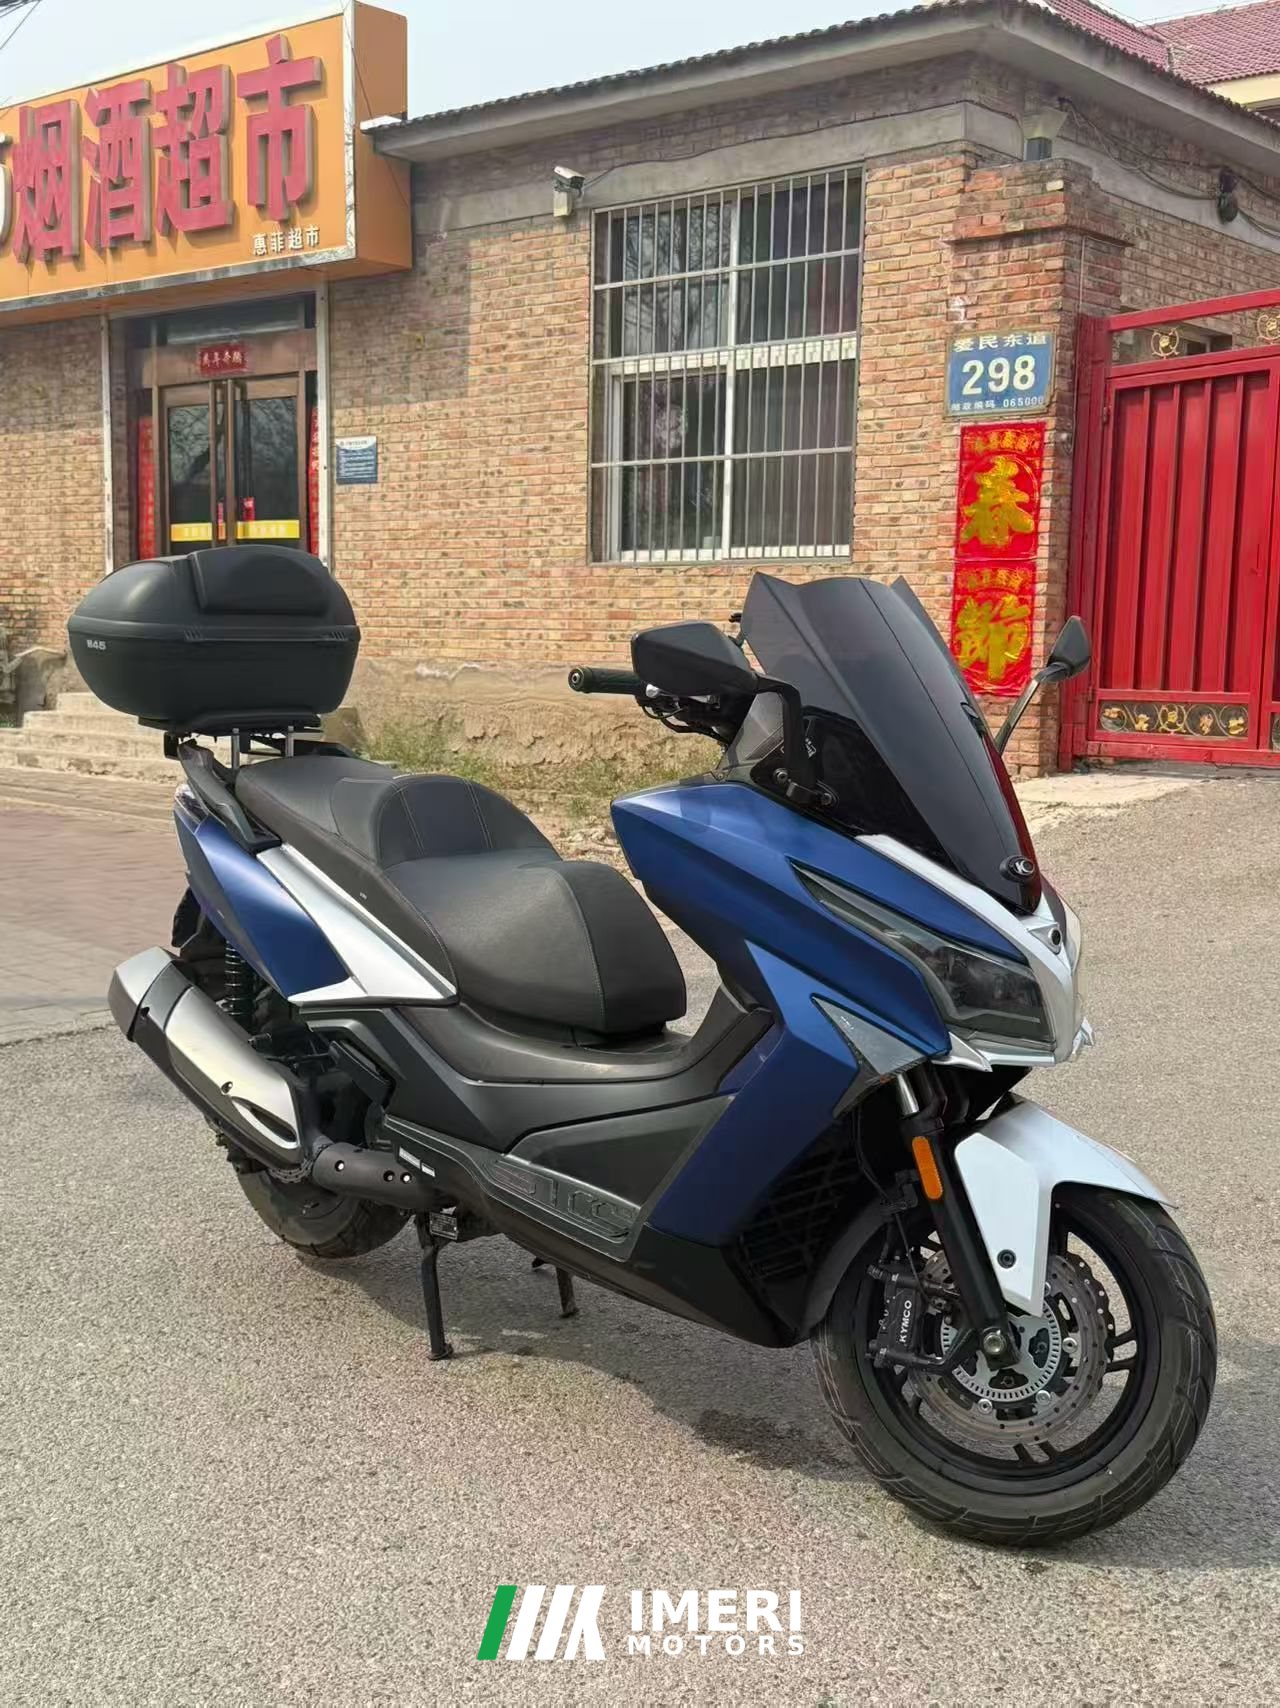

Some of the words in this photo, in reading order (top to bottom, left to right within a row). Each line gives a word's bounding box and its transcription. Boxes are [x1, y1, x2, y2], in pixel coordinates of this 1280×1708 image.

[12, 34, 320, 264] 烟酒超市
[252, 226, 320, 256] 惠菲超市
[954, 332, 1047, 352] 爱民东道
[962, 354, 1035, 395] 298
[899, 1300, 912, 1343] KYMCO
